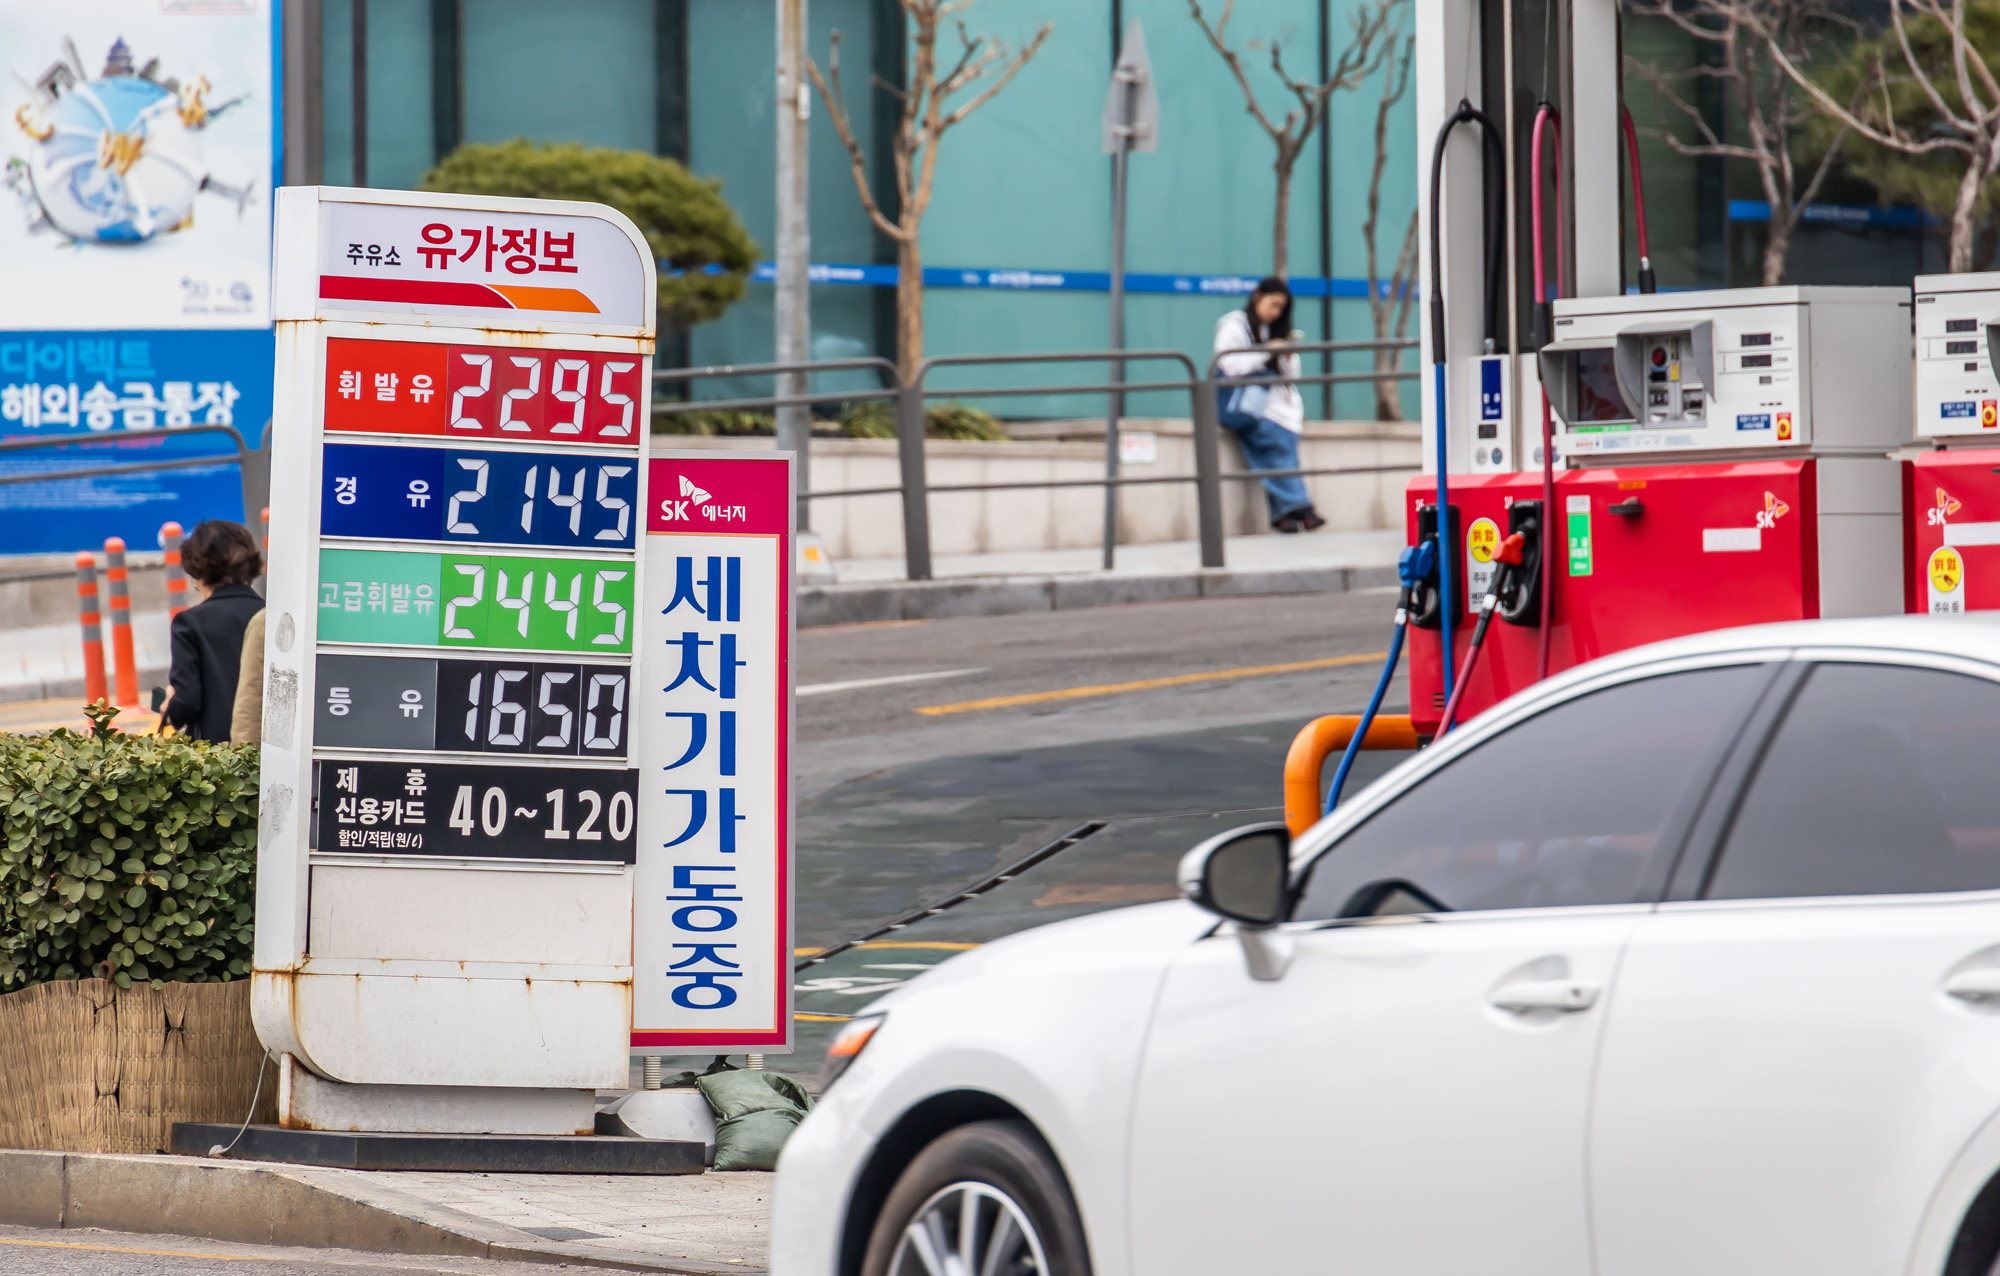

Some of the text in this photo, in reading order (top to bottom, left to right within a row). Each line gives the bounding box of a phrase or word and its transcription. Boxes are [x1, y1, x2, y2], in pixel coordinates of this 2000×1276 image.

[347, 222, 579, 275] 주유소 유가정보
[1, 338, 156, 383] 다이렉트
[1, 380, 241, 431] 해외송금통장
[450, 353, 637, 437] 2295
[446, 458, 633, 541] 2145
[661, 500, 746, 523] SK 에너지
[1756, 511, 1775, 528] SK
[1927, 508, 1946, 525] SK
[318, 563, 629, 645] 고급휘발유 2445
[464, 669, 627, 749] 1650
[335, 797, 426, 825] 신용카드
[448, 785, 634, 842] 40~120
